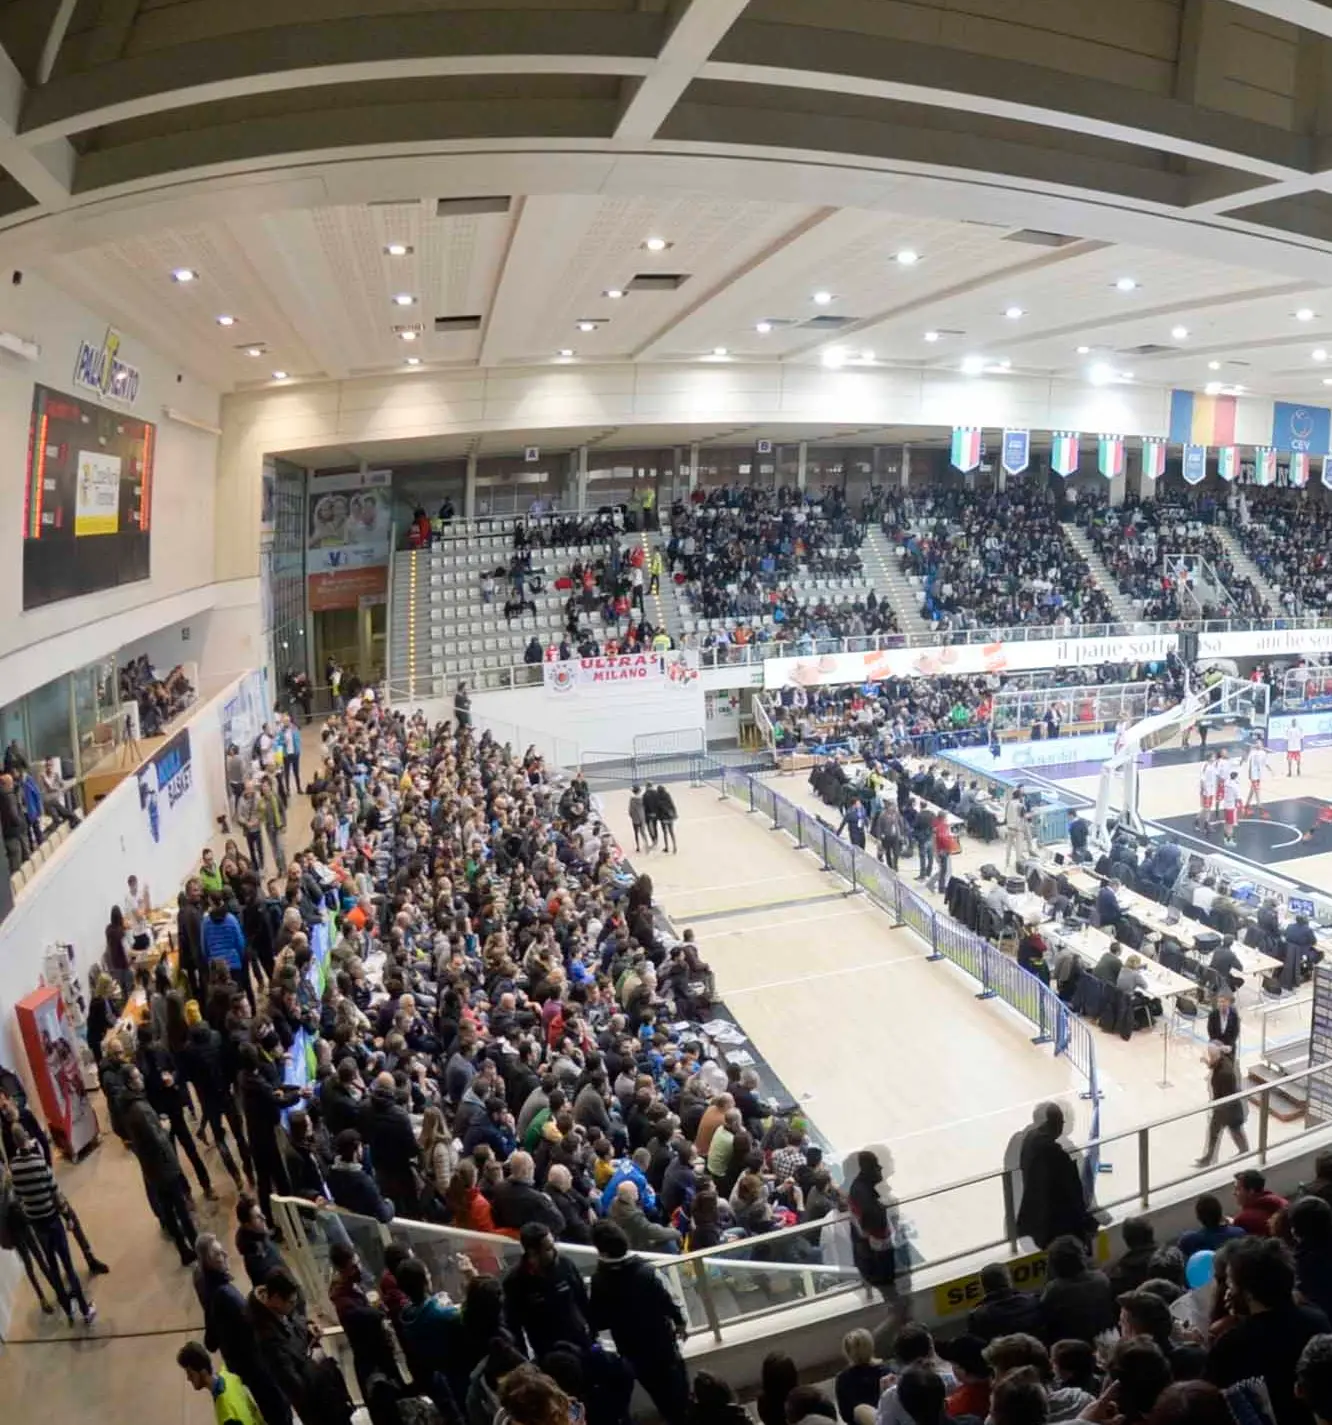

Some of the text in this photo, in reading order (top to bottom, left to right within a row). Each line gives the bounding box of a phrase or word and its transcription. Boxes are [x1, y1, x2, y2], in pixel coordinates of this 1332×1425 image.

[1291, 439, 1311, 450] CEV
[1257, 632, 1305, 650] anche
[1058, 641, 1068, 660] il
[1075, 643, 1123, 663] pane
[581, 653, 658, 669] ULTRAS
[593, 667, 647, 681] MILANO
